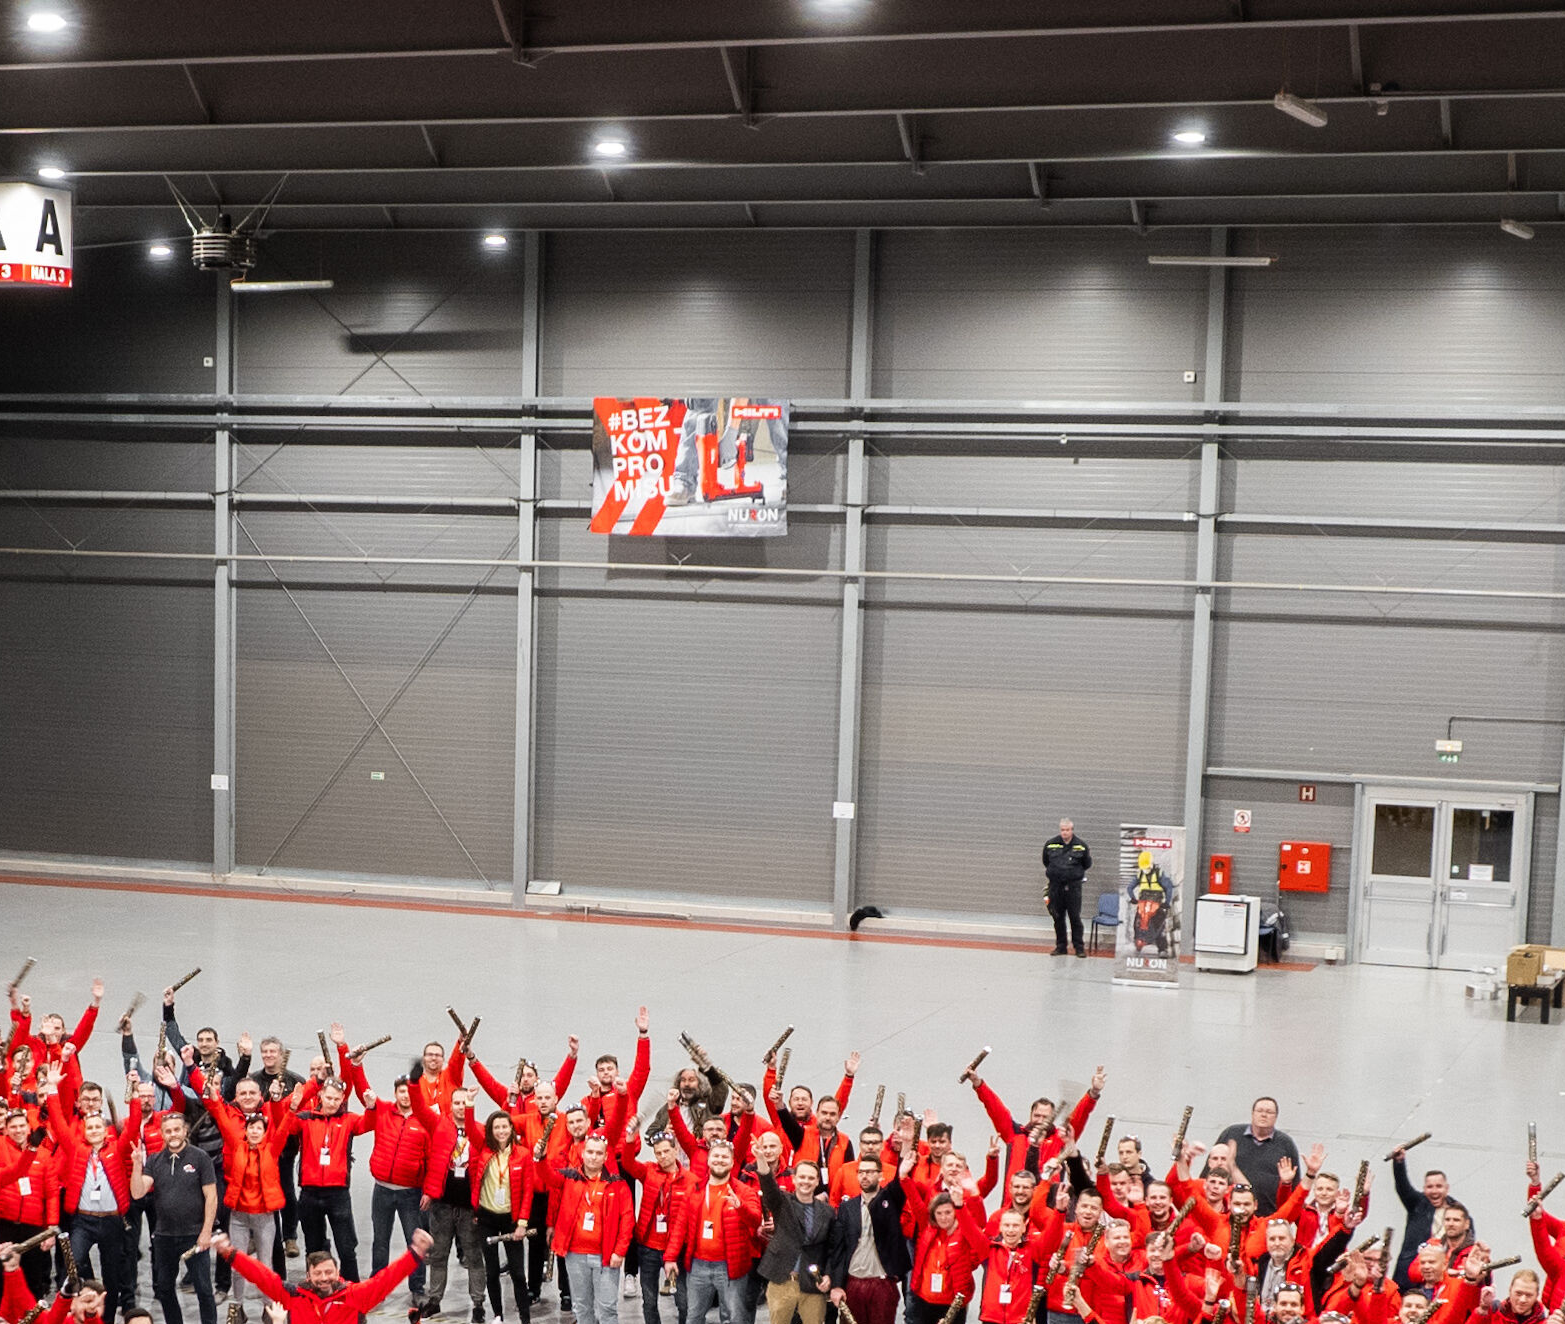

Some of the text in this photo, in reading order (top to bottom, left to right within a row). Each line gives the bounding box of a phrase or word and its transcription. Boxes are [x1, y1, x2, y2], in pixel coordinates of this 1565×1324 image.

[35, 199, 64, 256] A
[1, 264, 12, 279] 3
[31, 266, 66, 283] HALA 3
[608, 405, 671, 431] #BEZ
[610, 429, 667, 456] KOM
[612, 453, 664, 479] PRO
